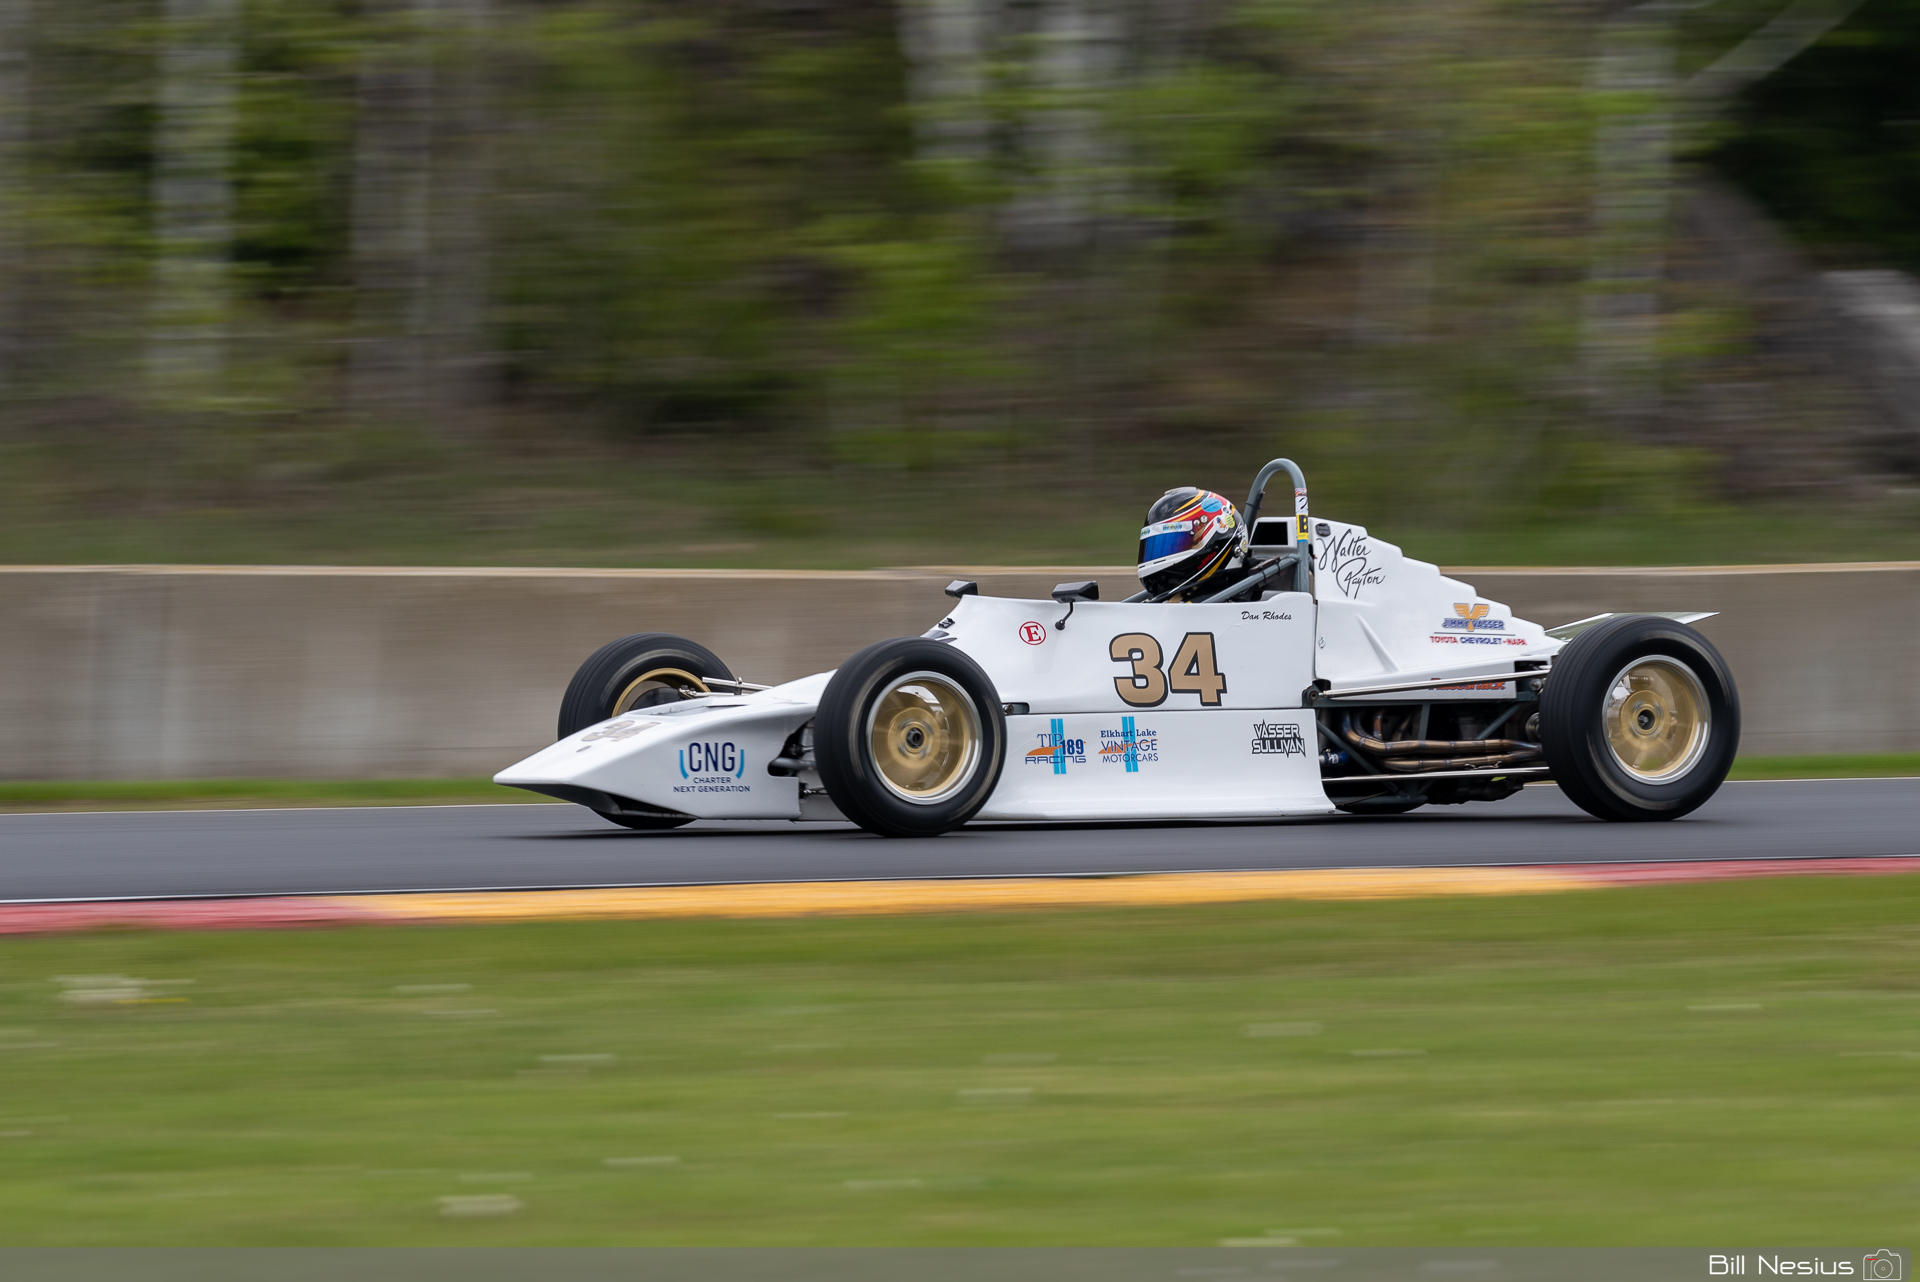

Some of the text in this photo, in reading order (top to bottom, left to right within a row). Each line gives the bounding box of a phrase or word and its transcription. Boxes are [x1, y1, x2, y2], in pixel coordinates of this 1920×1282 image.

[1316, 529, 1372, 573] Walter
[1336, 557, 1386, 599] Payton
[1241, 611, 1292, 620] Dan Rhodes
[1442, 618, 1505, 630] JIMMY VASSER
[1024, 625, 1041, 642] E
[1429, 636, 1458, 644] TOYOTA
[1460, 636, 1502, 645] CHEVROLET
[1109, 632, 1227, 707] 34
[581, 720, 661, 742] 34
[1100, 729, 1157, 738] Elkhart Lake
[1253, 719, 1301, 739] VASSER
[1037, 733, 1063, 748] TIP
[1061, 738, 1084, 755] 189
[1101, 739, 1158, 752] VINTAGE
[1251, 738, 1306, 758] SULLIVAN
[688, 742, 736, 772] CNG
[1025, 755, 1086, 764] RACING
[1102, 753, 1159, 763] MOTORCARS
[698, 785, 750, 793] GENERATION
